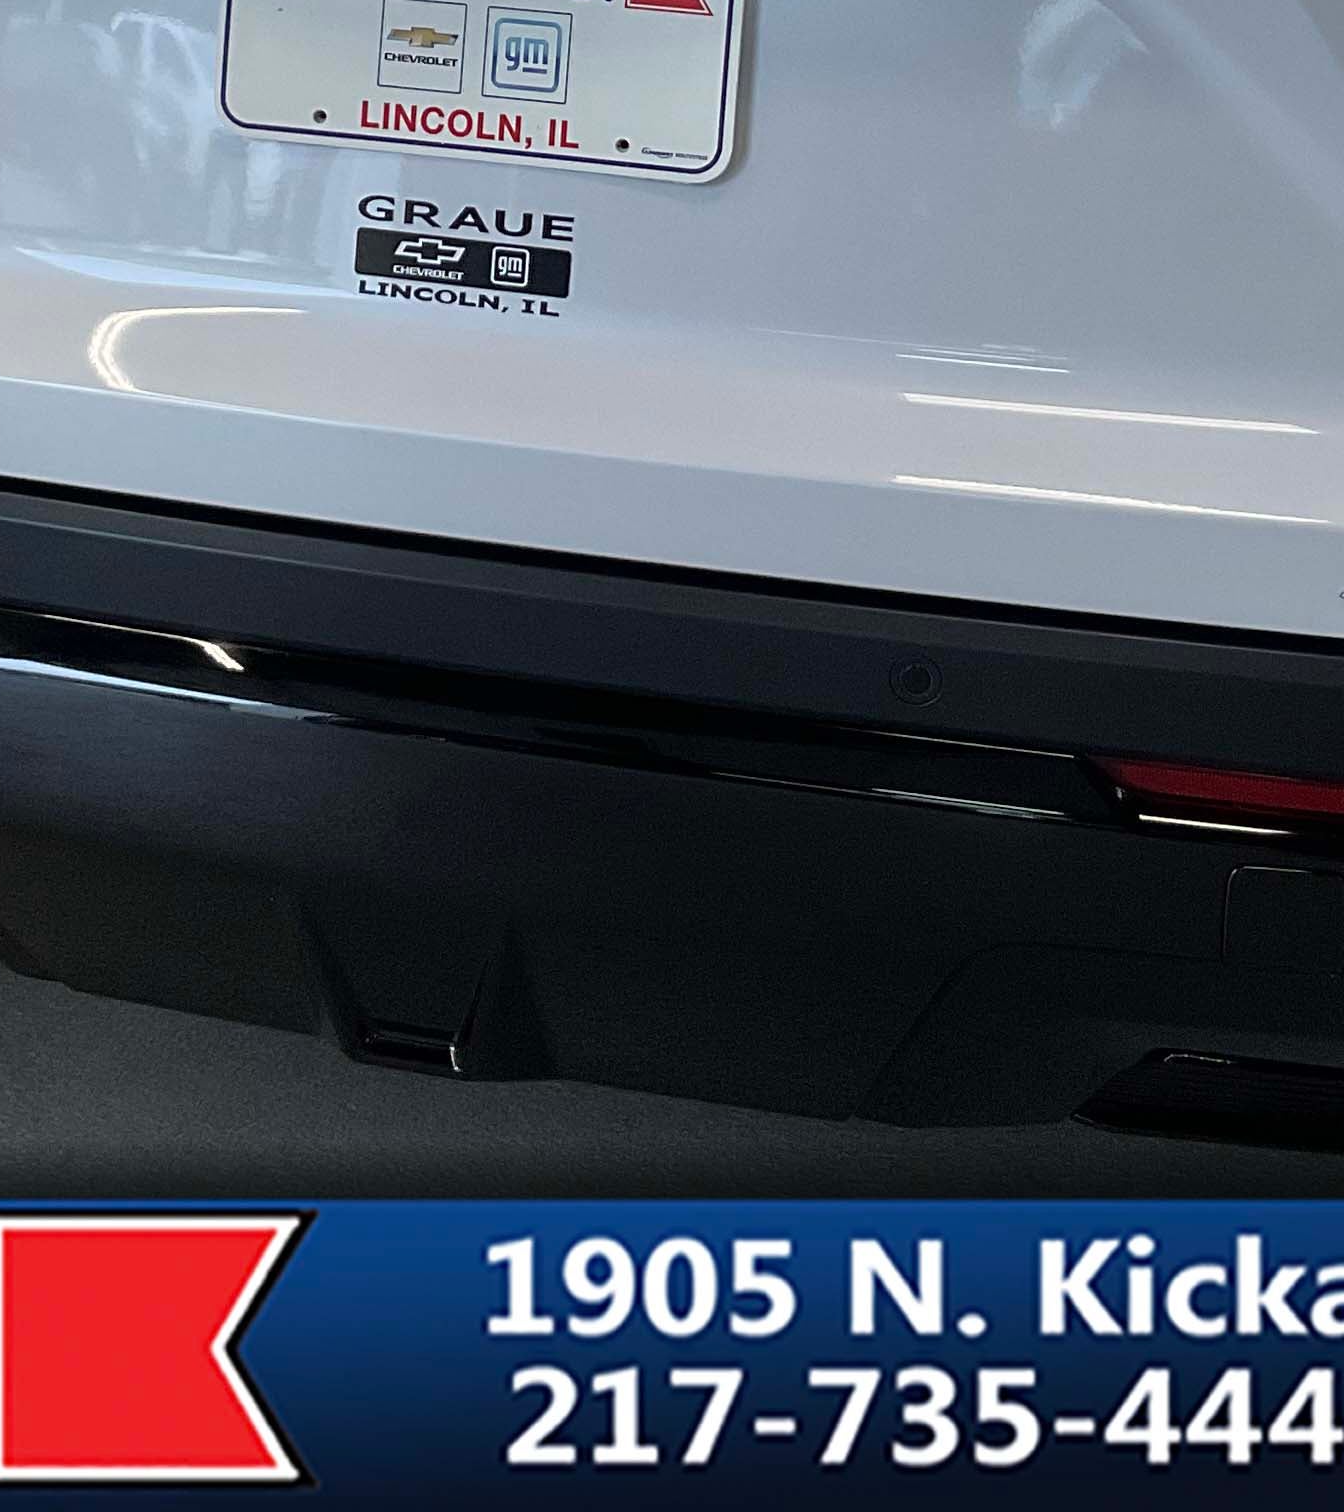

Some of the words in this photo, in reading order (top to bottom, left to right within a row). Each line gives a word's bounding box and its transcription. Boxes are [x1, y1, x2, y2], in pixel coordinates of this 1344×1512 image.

[384, 52, 458, 68] CHEVROLET
[504, 36, 550, 73] gm
[359, 100, 532, 148] LINCOLN,
[547, 119, 580, 149] IL
[358, 195, 575, 242] GRAUE
[392, 264, 464, 281] CHEVROLET
[497, 256, 523, 276] gm
[359, 280, 509, 313] LINCOLN,
[521, 299, 560, 317] IL
